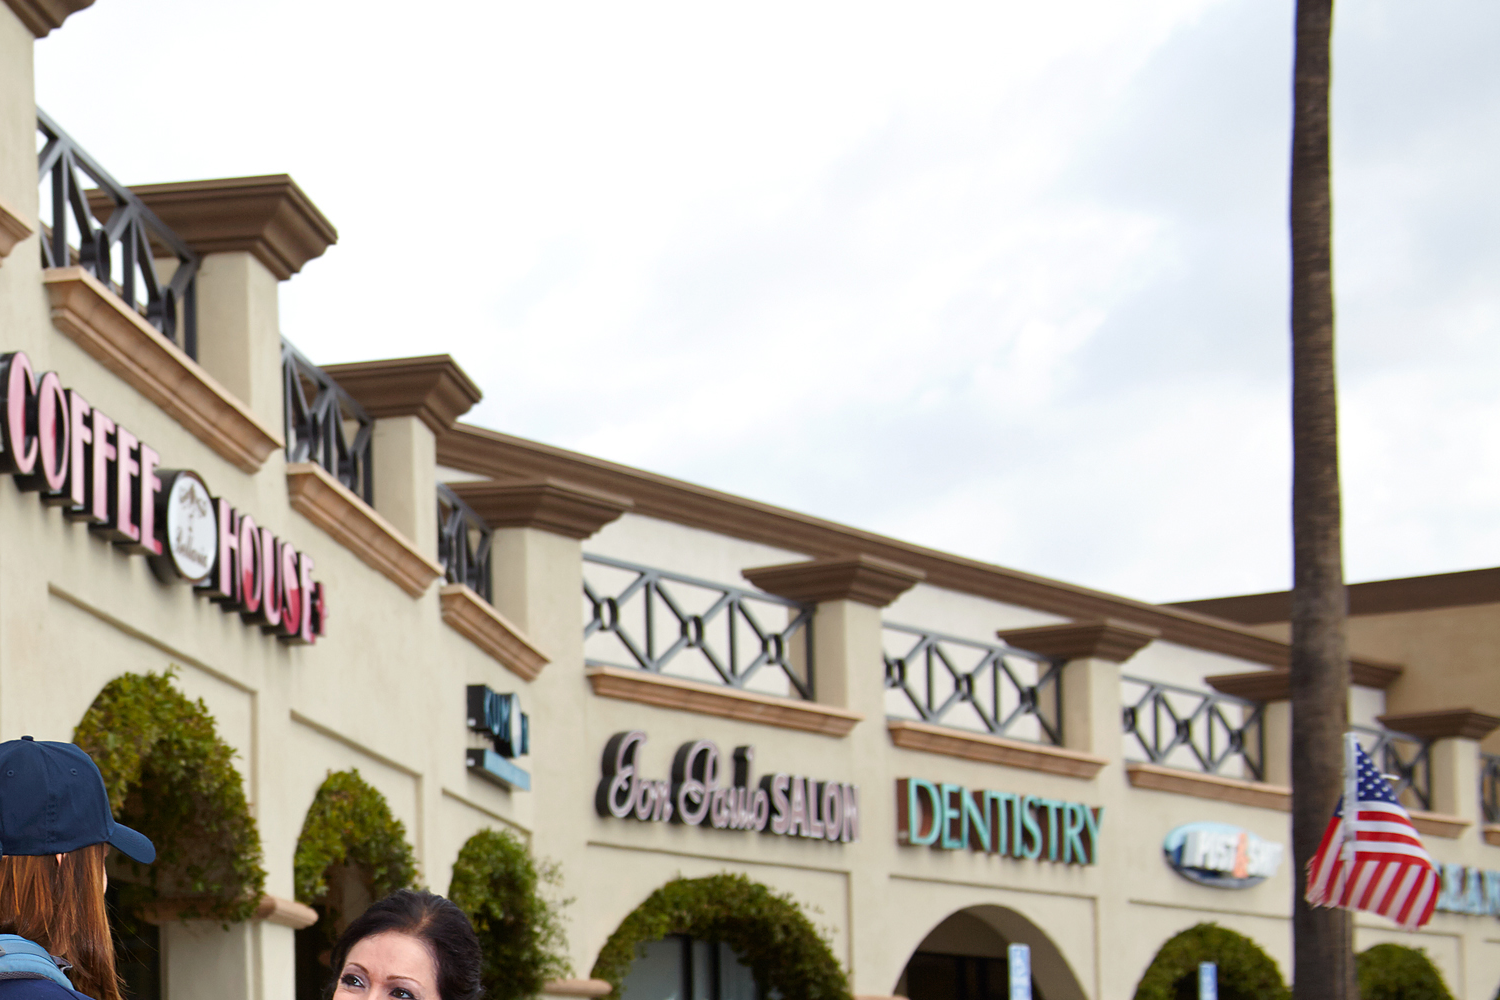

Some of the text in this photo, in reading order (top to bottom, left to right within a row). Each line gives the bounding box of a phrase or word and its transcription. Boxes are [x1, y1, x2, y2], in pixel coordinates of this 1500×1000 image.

[6, 350, 163, 556] COFFEE
[219, 498, 317, 644] HOUSE
[770, 772, 860, 843] SALON
[907, 777, 1105, 866] DENTISTRY
